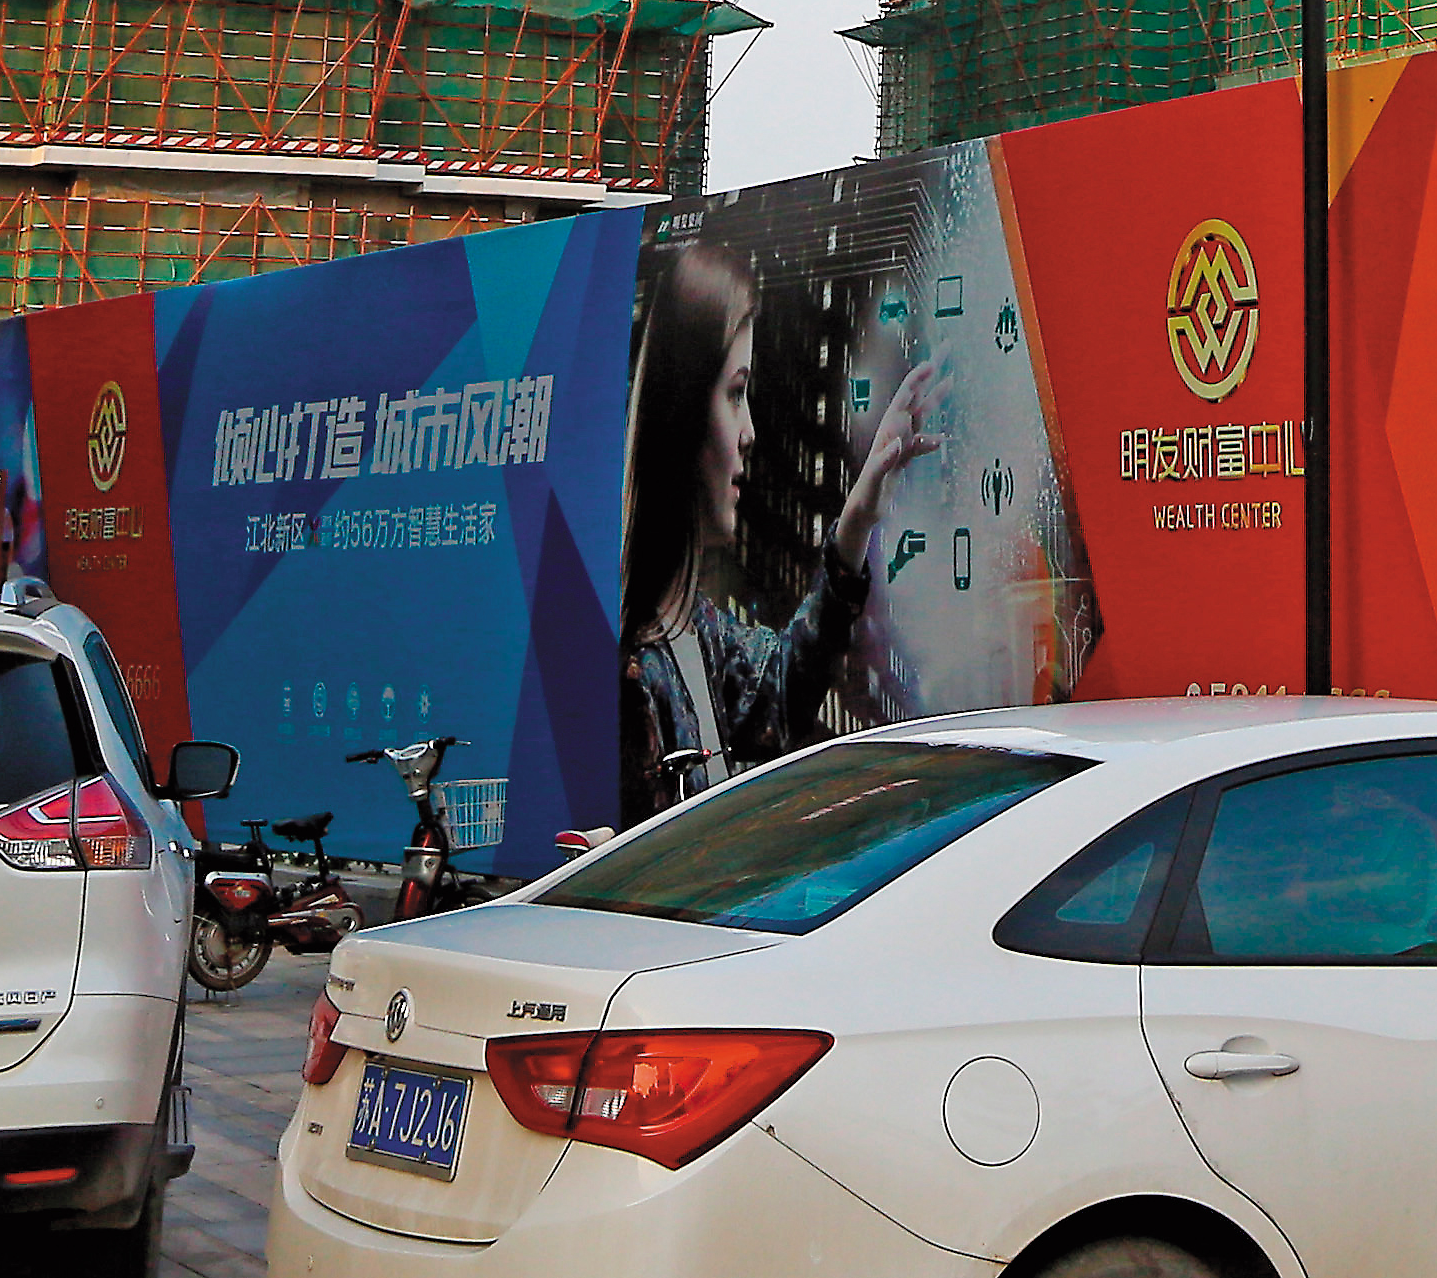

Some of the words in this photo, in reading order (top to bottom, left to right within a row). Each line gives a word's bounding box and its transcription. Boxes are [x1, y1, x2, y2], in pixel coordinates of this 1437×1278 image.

[212, 396, 366, 486] 倾心打造
[369, 374, 555, 475] 城市风潮
[246, 512, 307, 553] 江北新区
[1153, 503, 1215, 530] WEALTH
[1221, 501, 1282, 530] CENTER
[119, 664, 161, 700] 6666
